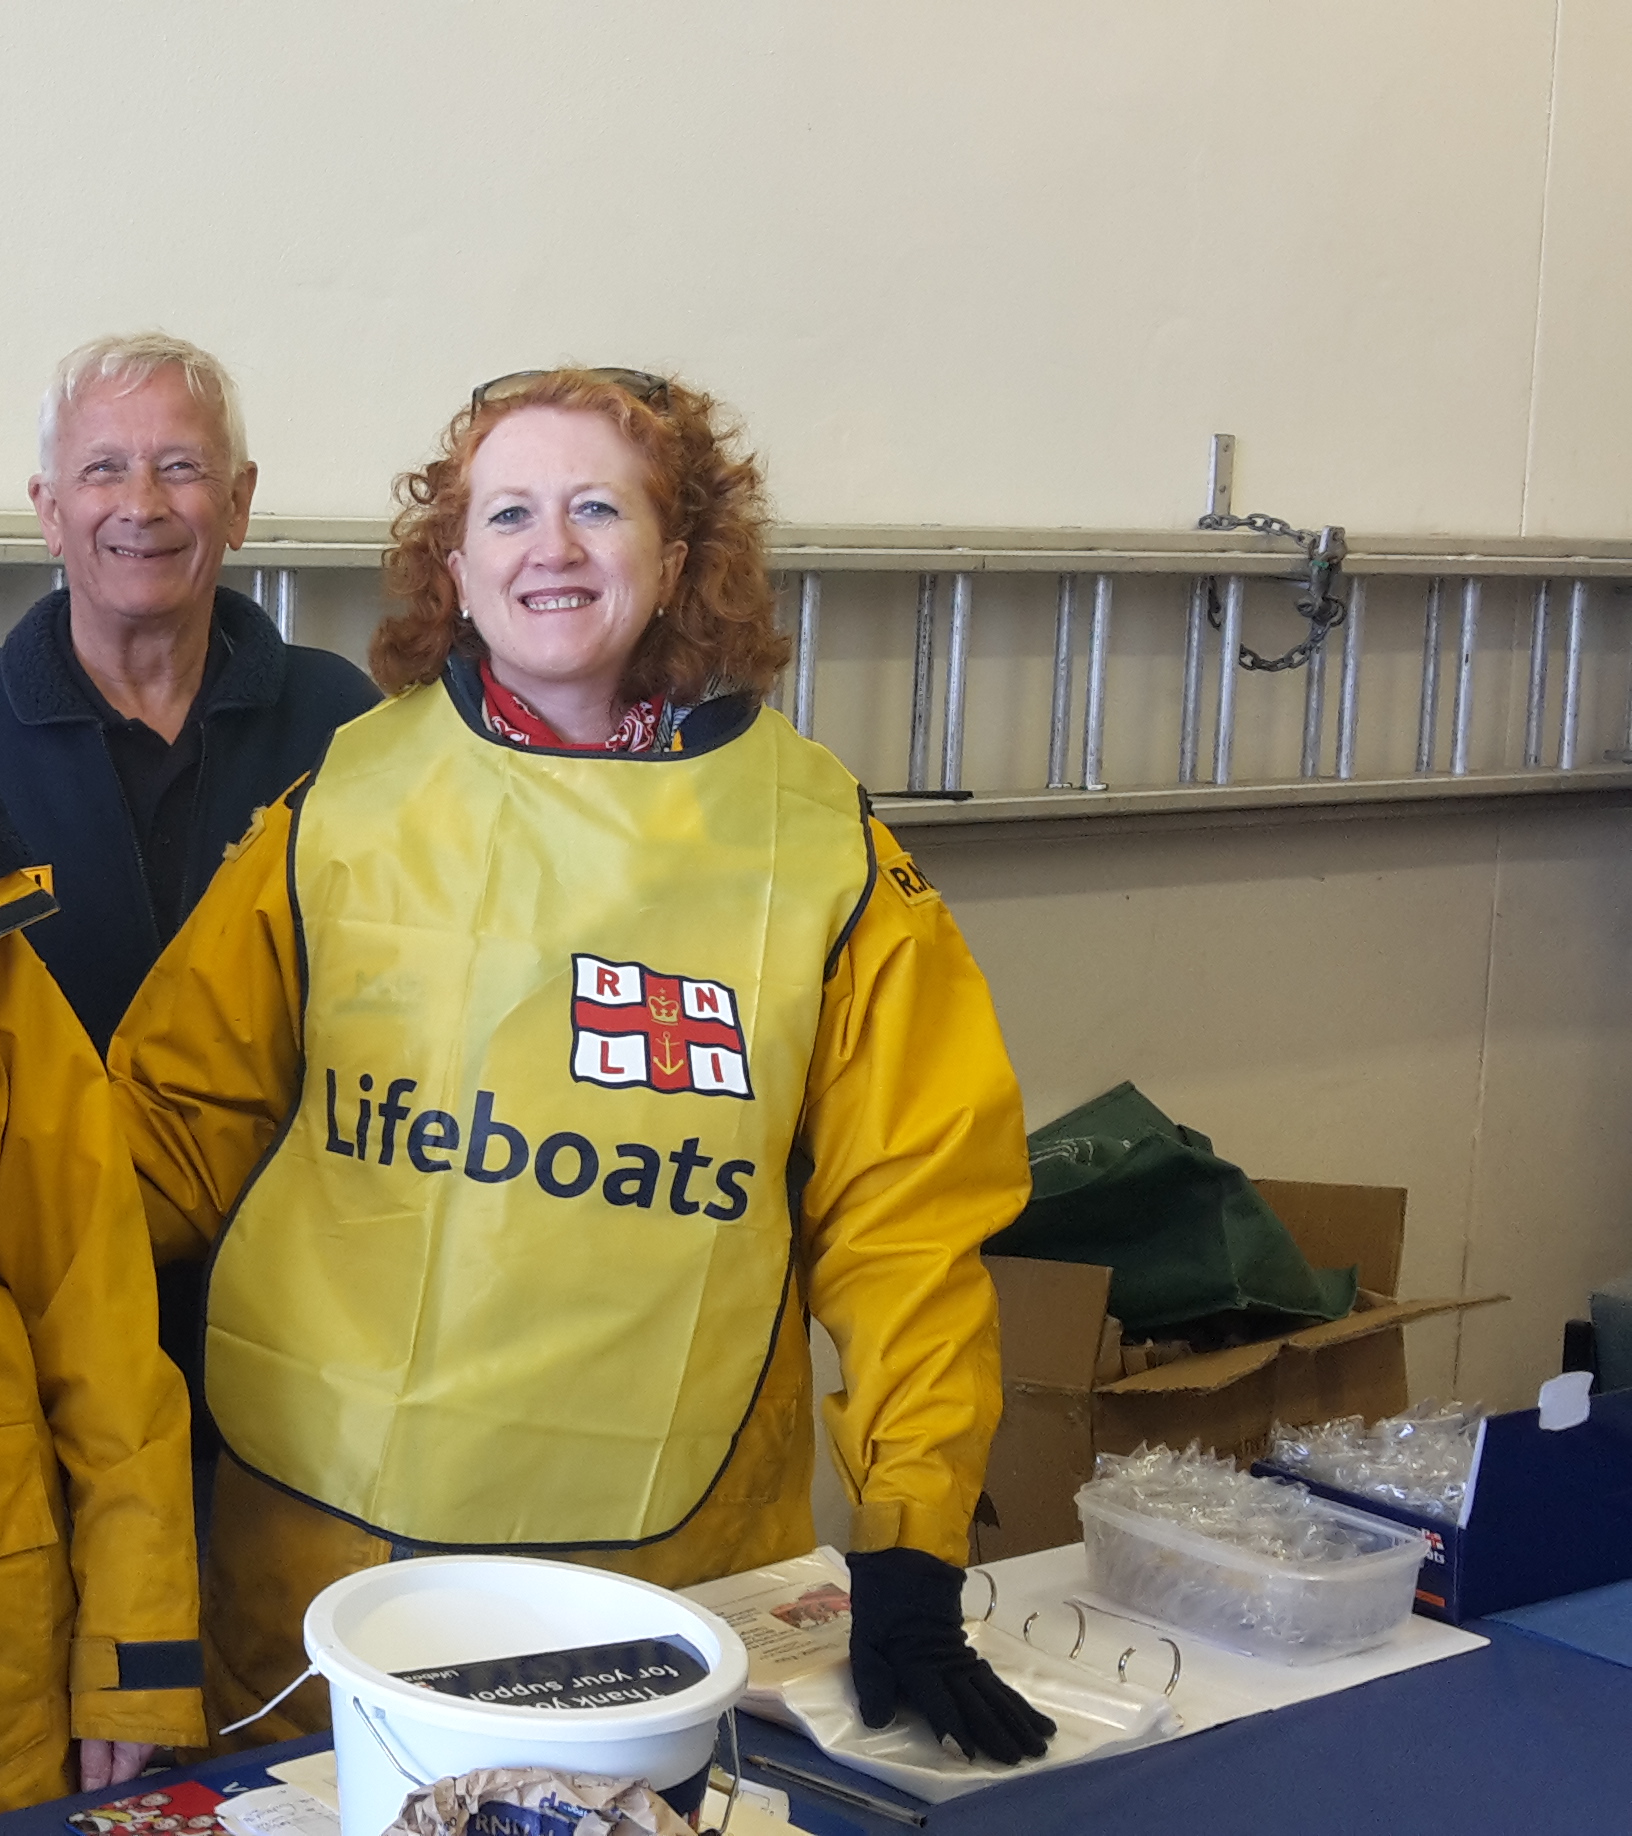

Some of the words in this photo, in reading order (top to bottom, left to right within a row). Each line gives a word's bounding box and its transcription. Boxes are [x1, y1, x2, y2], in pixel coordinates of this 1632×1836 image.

[325, 1067, 756, 1222] Lifeboats
[572, 1668, 633, 1689] your
[638, 1664, 680, 1679] for
[469, 1680, 564, 1702] suppor
[571, 1686, 665, 1708] Thank
[521, 1696, 571, 1710] yo
